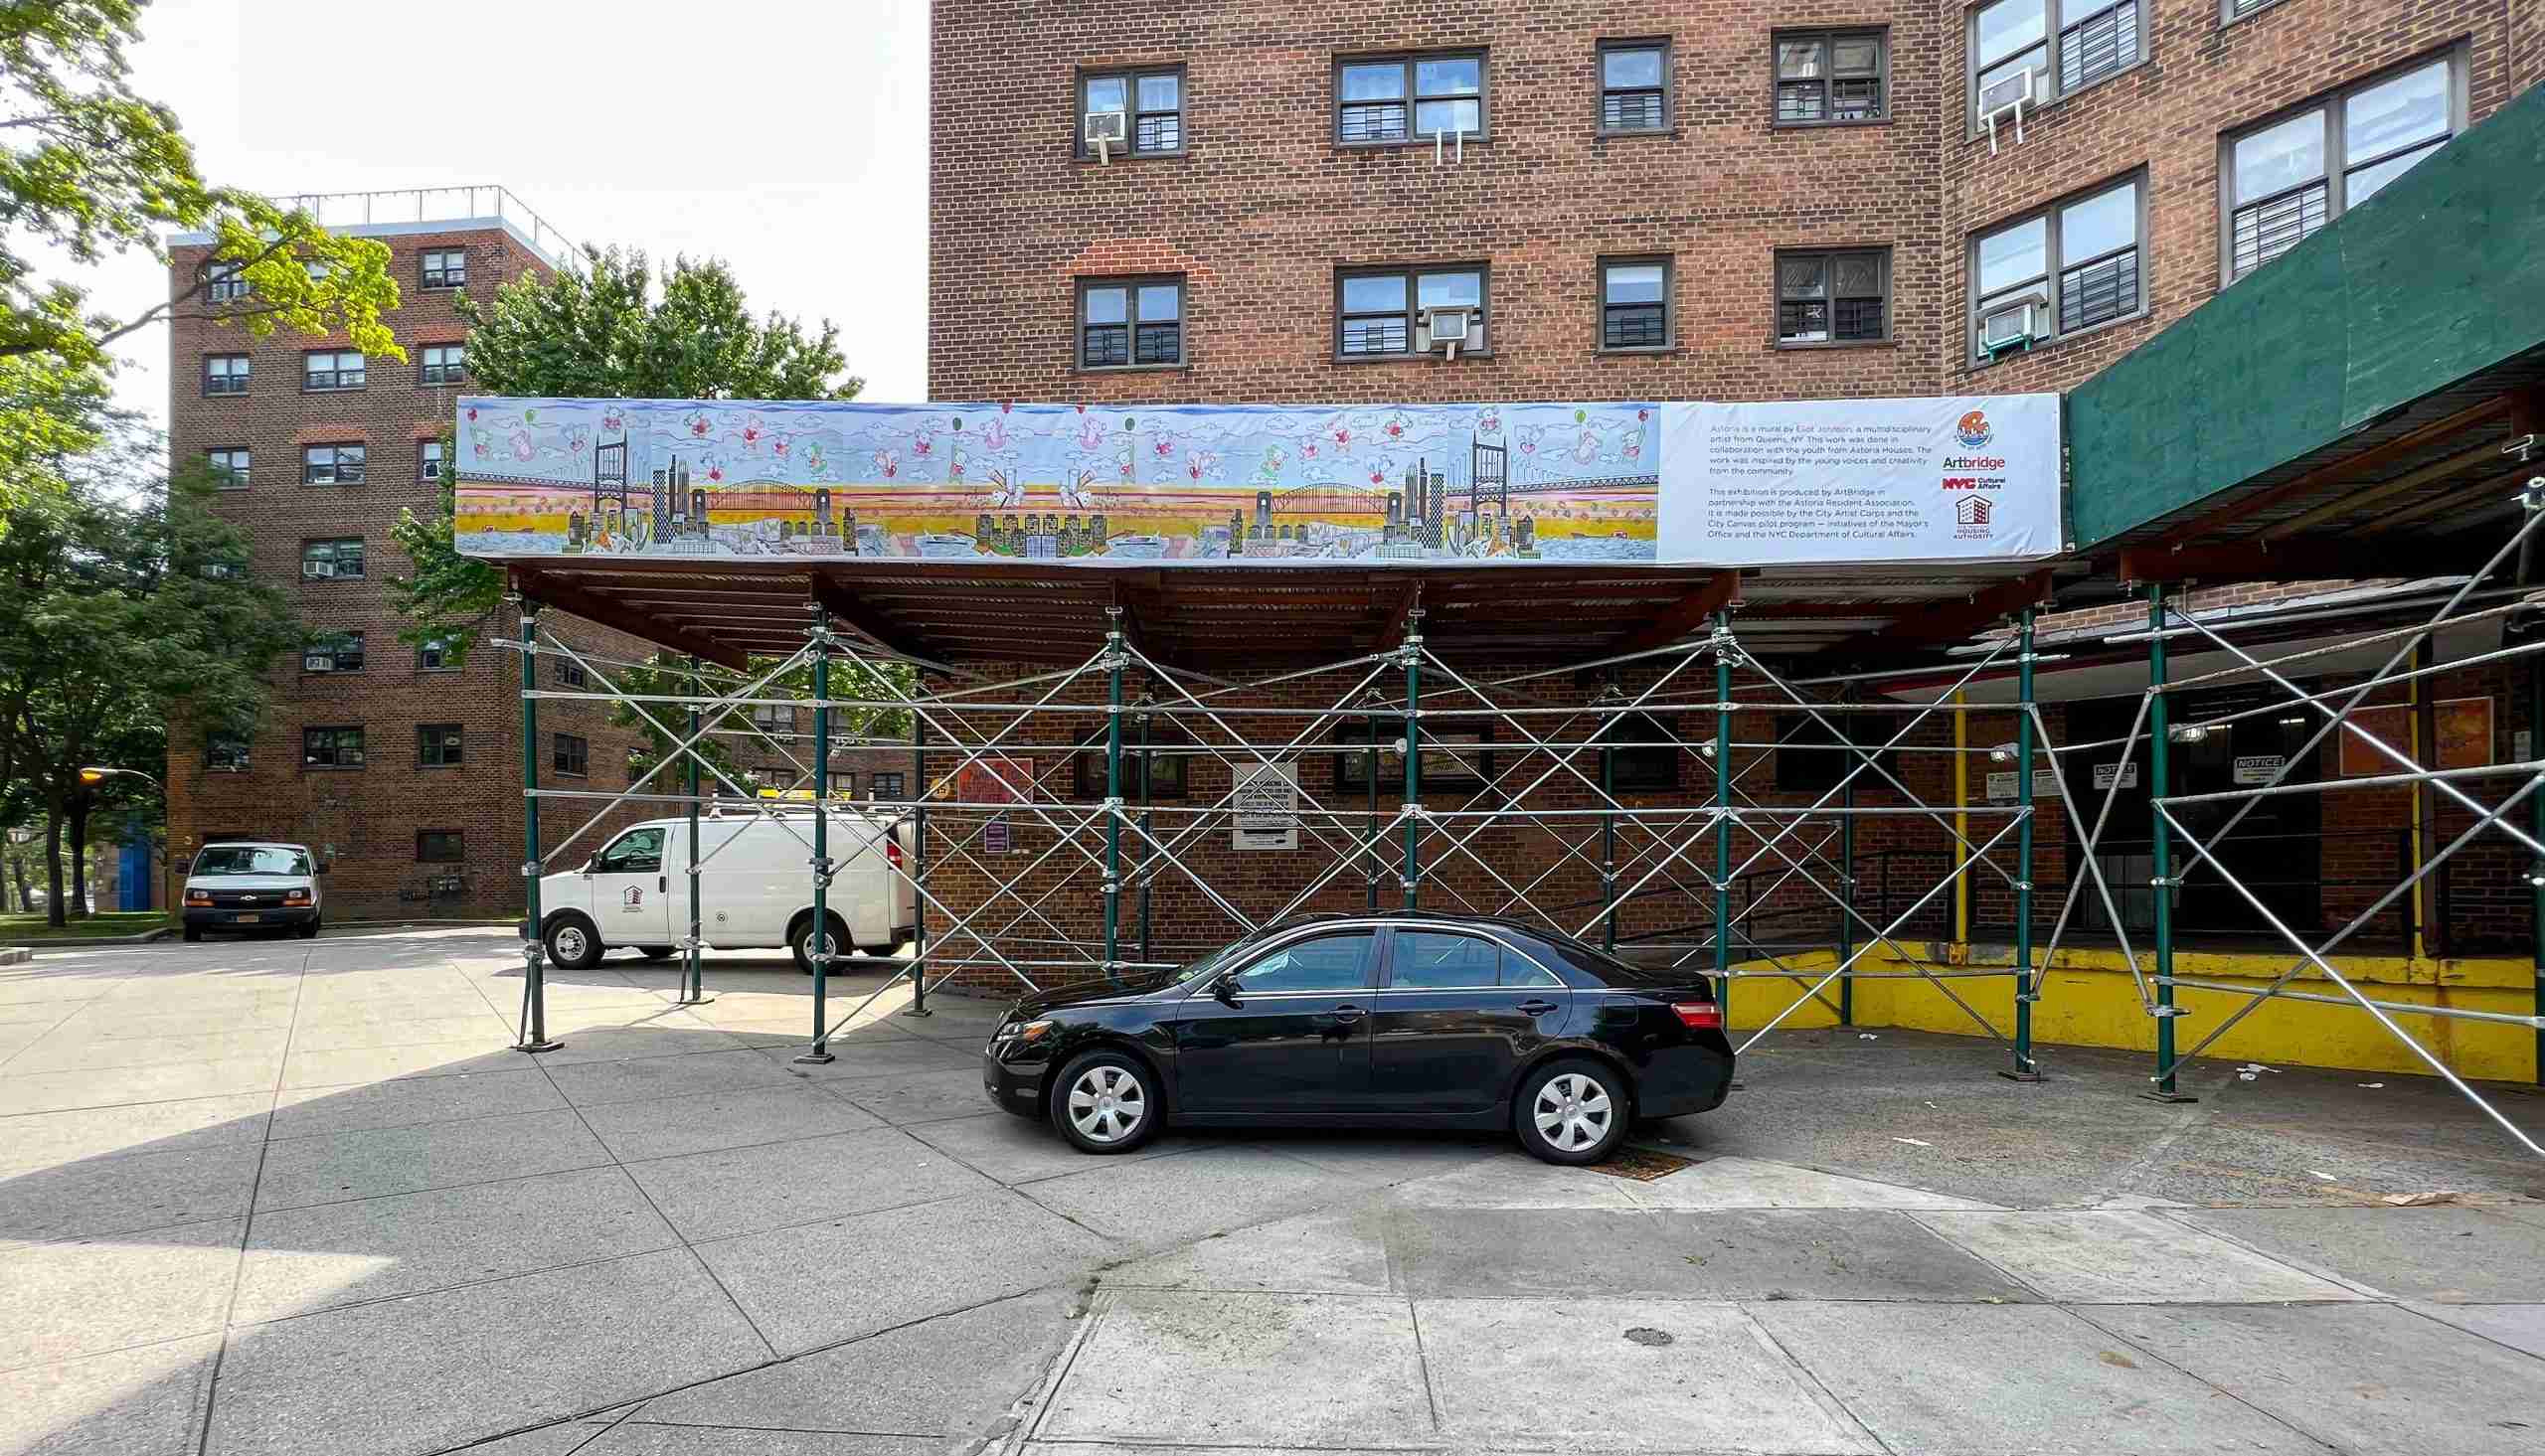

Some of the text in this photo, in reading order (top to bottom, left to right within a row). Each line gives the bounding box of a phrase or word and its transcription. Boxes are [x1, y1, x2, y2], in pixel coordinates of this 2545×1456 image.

[1801, 445, 1825, 455] youth
[1751, 456, 1782, 466] inspired
[1785, 456, 1796, 466] by
[1814, 457, 1839, 466] young
[1888, 456, 1927, 466] creativity
[1944, 456, 2005, 470] Artbridge
[1943, 478, 1976, 489] NYC
[1780, 488, 1820, 498] produced
[1821, 488, 1831, 498] by
[1708, 499, 1756, 509] partnership
[1750, 509, 1784, 519] possible
[1786, 509, 1797, 519] by
[1815, 509, 1831, 519] City
[1859, 509, 1885, 519] Corps
[1707, 520, 1724, 530] City
[1758, 520, 1778, 530] pilot
[1780, 521, 1815, 530] program
[1788, 530, 1839, 540] Department
[2238, 757, 2282, 767] NOTICE
[2098, 764, 2134, 774] NOTE
